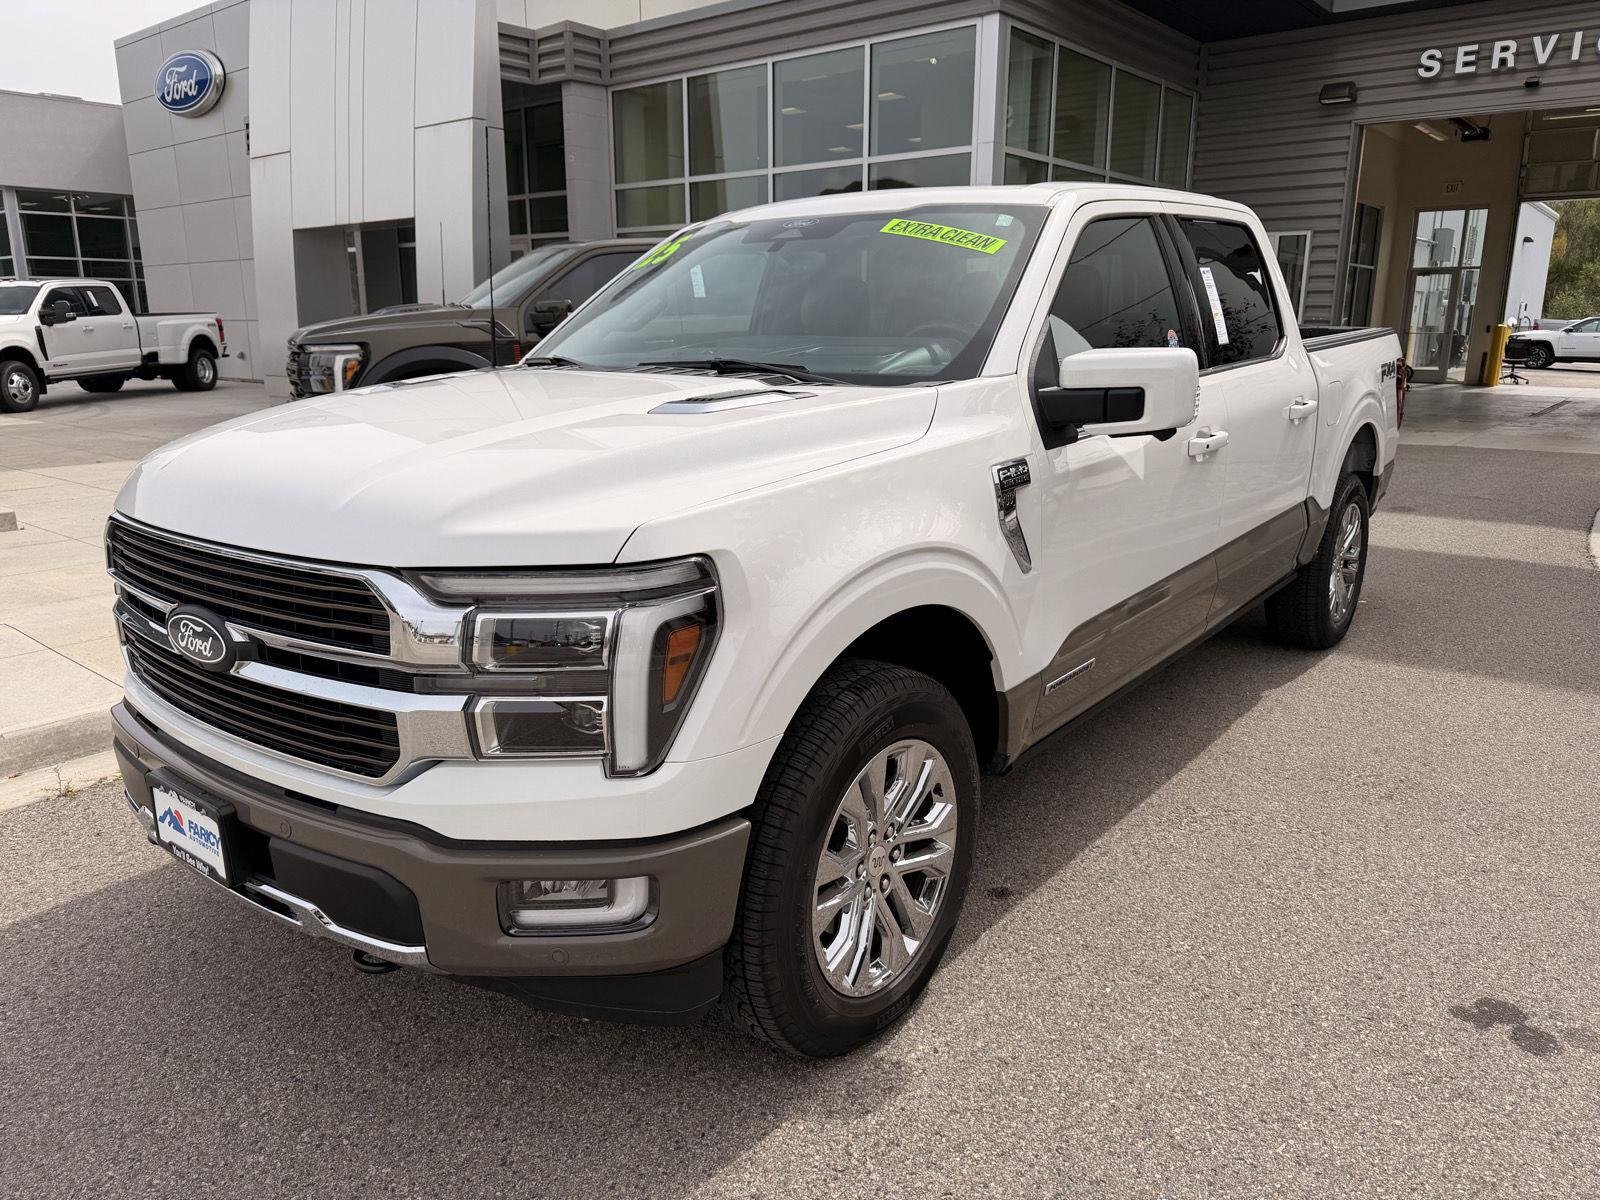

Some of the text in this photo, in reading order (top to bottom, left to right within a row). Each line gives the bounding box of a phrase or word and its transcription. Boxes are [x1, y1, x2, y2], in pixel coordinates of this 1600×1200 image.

[1417, 31, 1600, 78] SERVI
[164, 64, 199, 103] Ford
[888, 220, 997, 251] EXTRA CLEAN
[178, 619, 214, 658] Ford
[188, 819, 221, 850] FARICY
[186, 853, 196, 867] See
